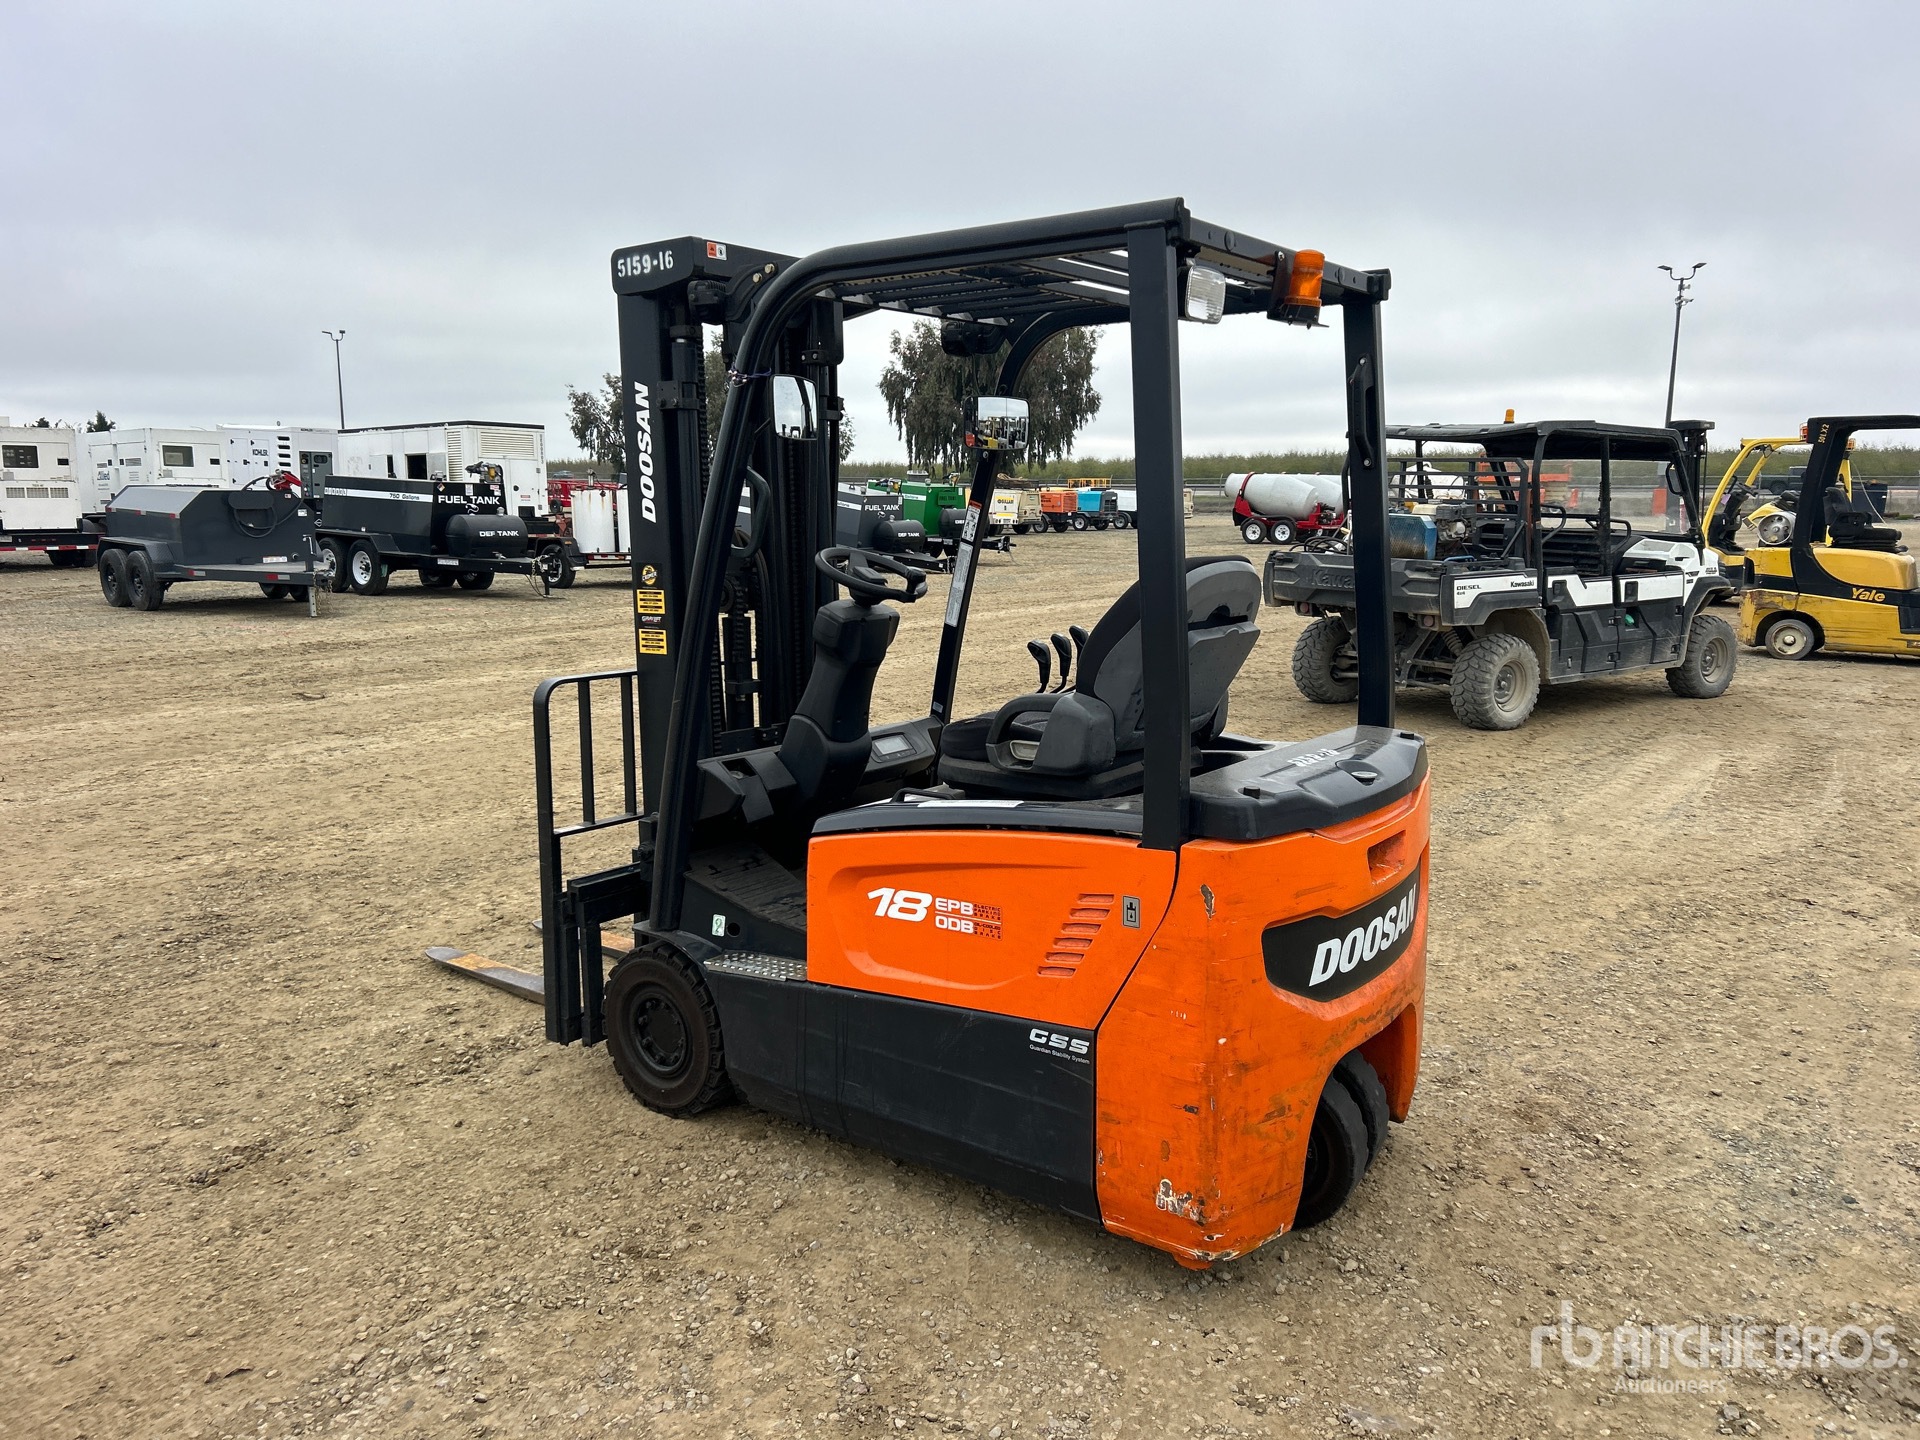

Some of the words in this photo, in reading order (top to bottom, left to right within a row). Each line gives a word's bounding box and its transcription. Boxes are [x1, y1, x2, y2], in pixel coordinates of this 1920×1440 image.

[617, 250, 674, 277] 5159-16
[634, 381, 657, 523] DOOSAN
[438, 495, 467, 504] FUEL
[470, 496, 500, 505] TANK
[1511, 580, 1535, 588] Kawasaki
[1852, 587, 1886, 602] Yale
[867, 887, 933, 922] 18
[935, 897, 974, 916] EPB
[935, 915, 974, 934] ODB
[1309, 883, 1417, 987] DOOSAN
[1029, 1028, 1090, 1055] GSS
[1029, 1044, 1052, 1054] Guardian
[1052, 1050, 1071, 1061] Stability
[1071, 1055, 1090, 1065] System
